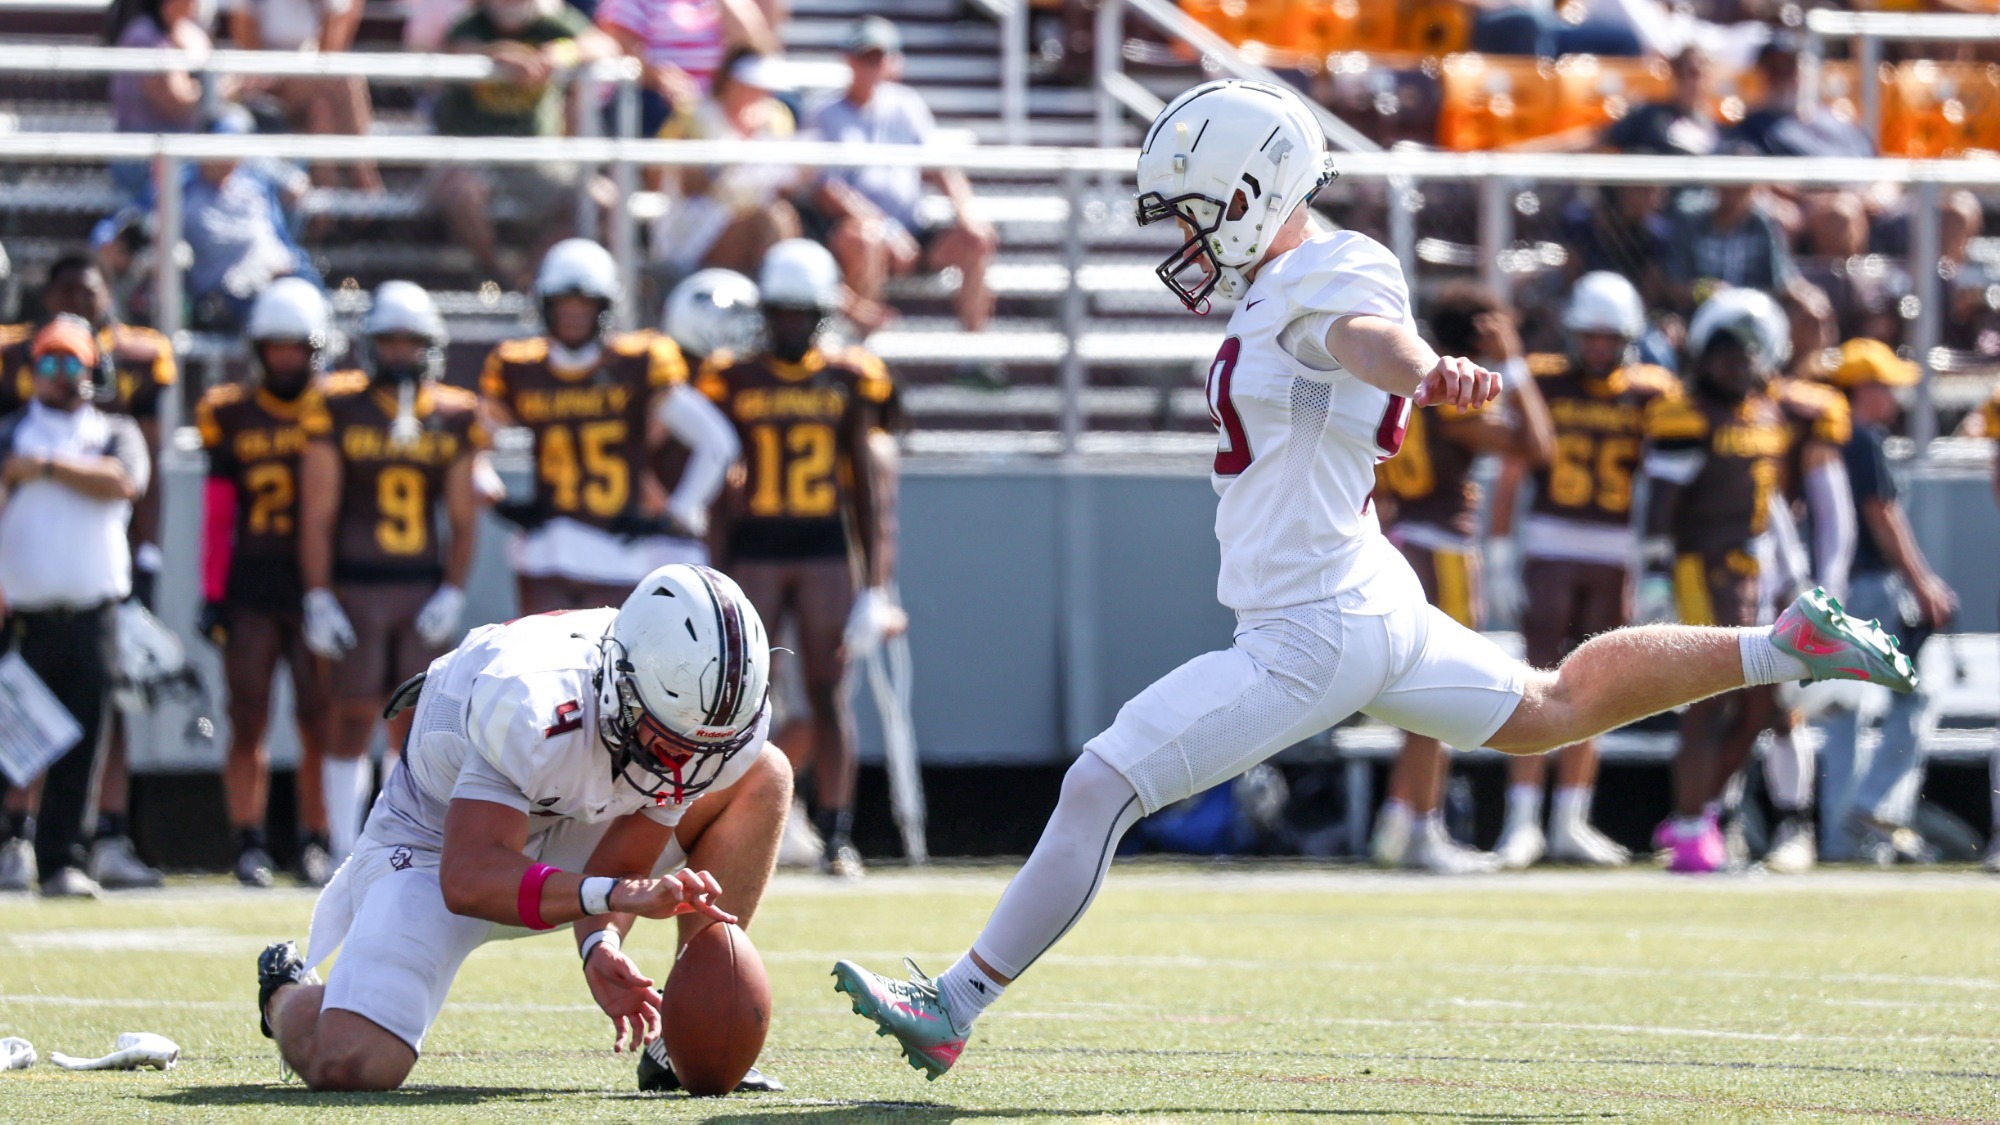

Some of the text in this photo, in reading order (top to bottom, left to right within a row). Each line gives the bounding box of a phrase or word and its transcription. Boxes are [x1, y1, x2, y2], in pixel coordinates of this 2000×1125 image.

[376, 465, 427, 555] 9
[540, 420, 630, 517] 45
[750, 423, 837, 517] 12
[1548, 432, 1636, 513] 65
[695, 729, 735, 738] Riddell
